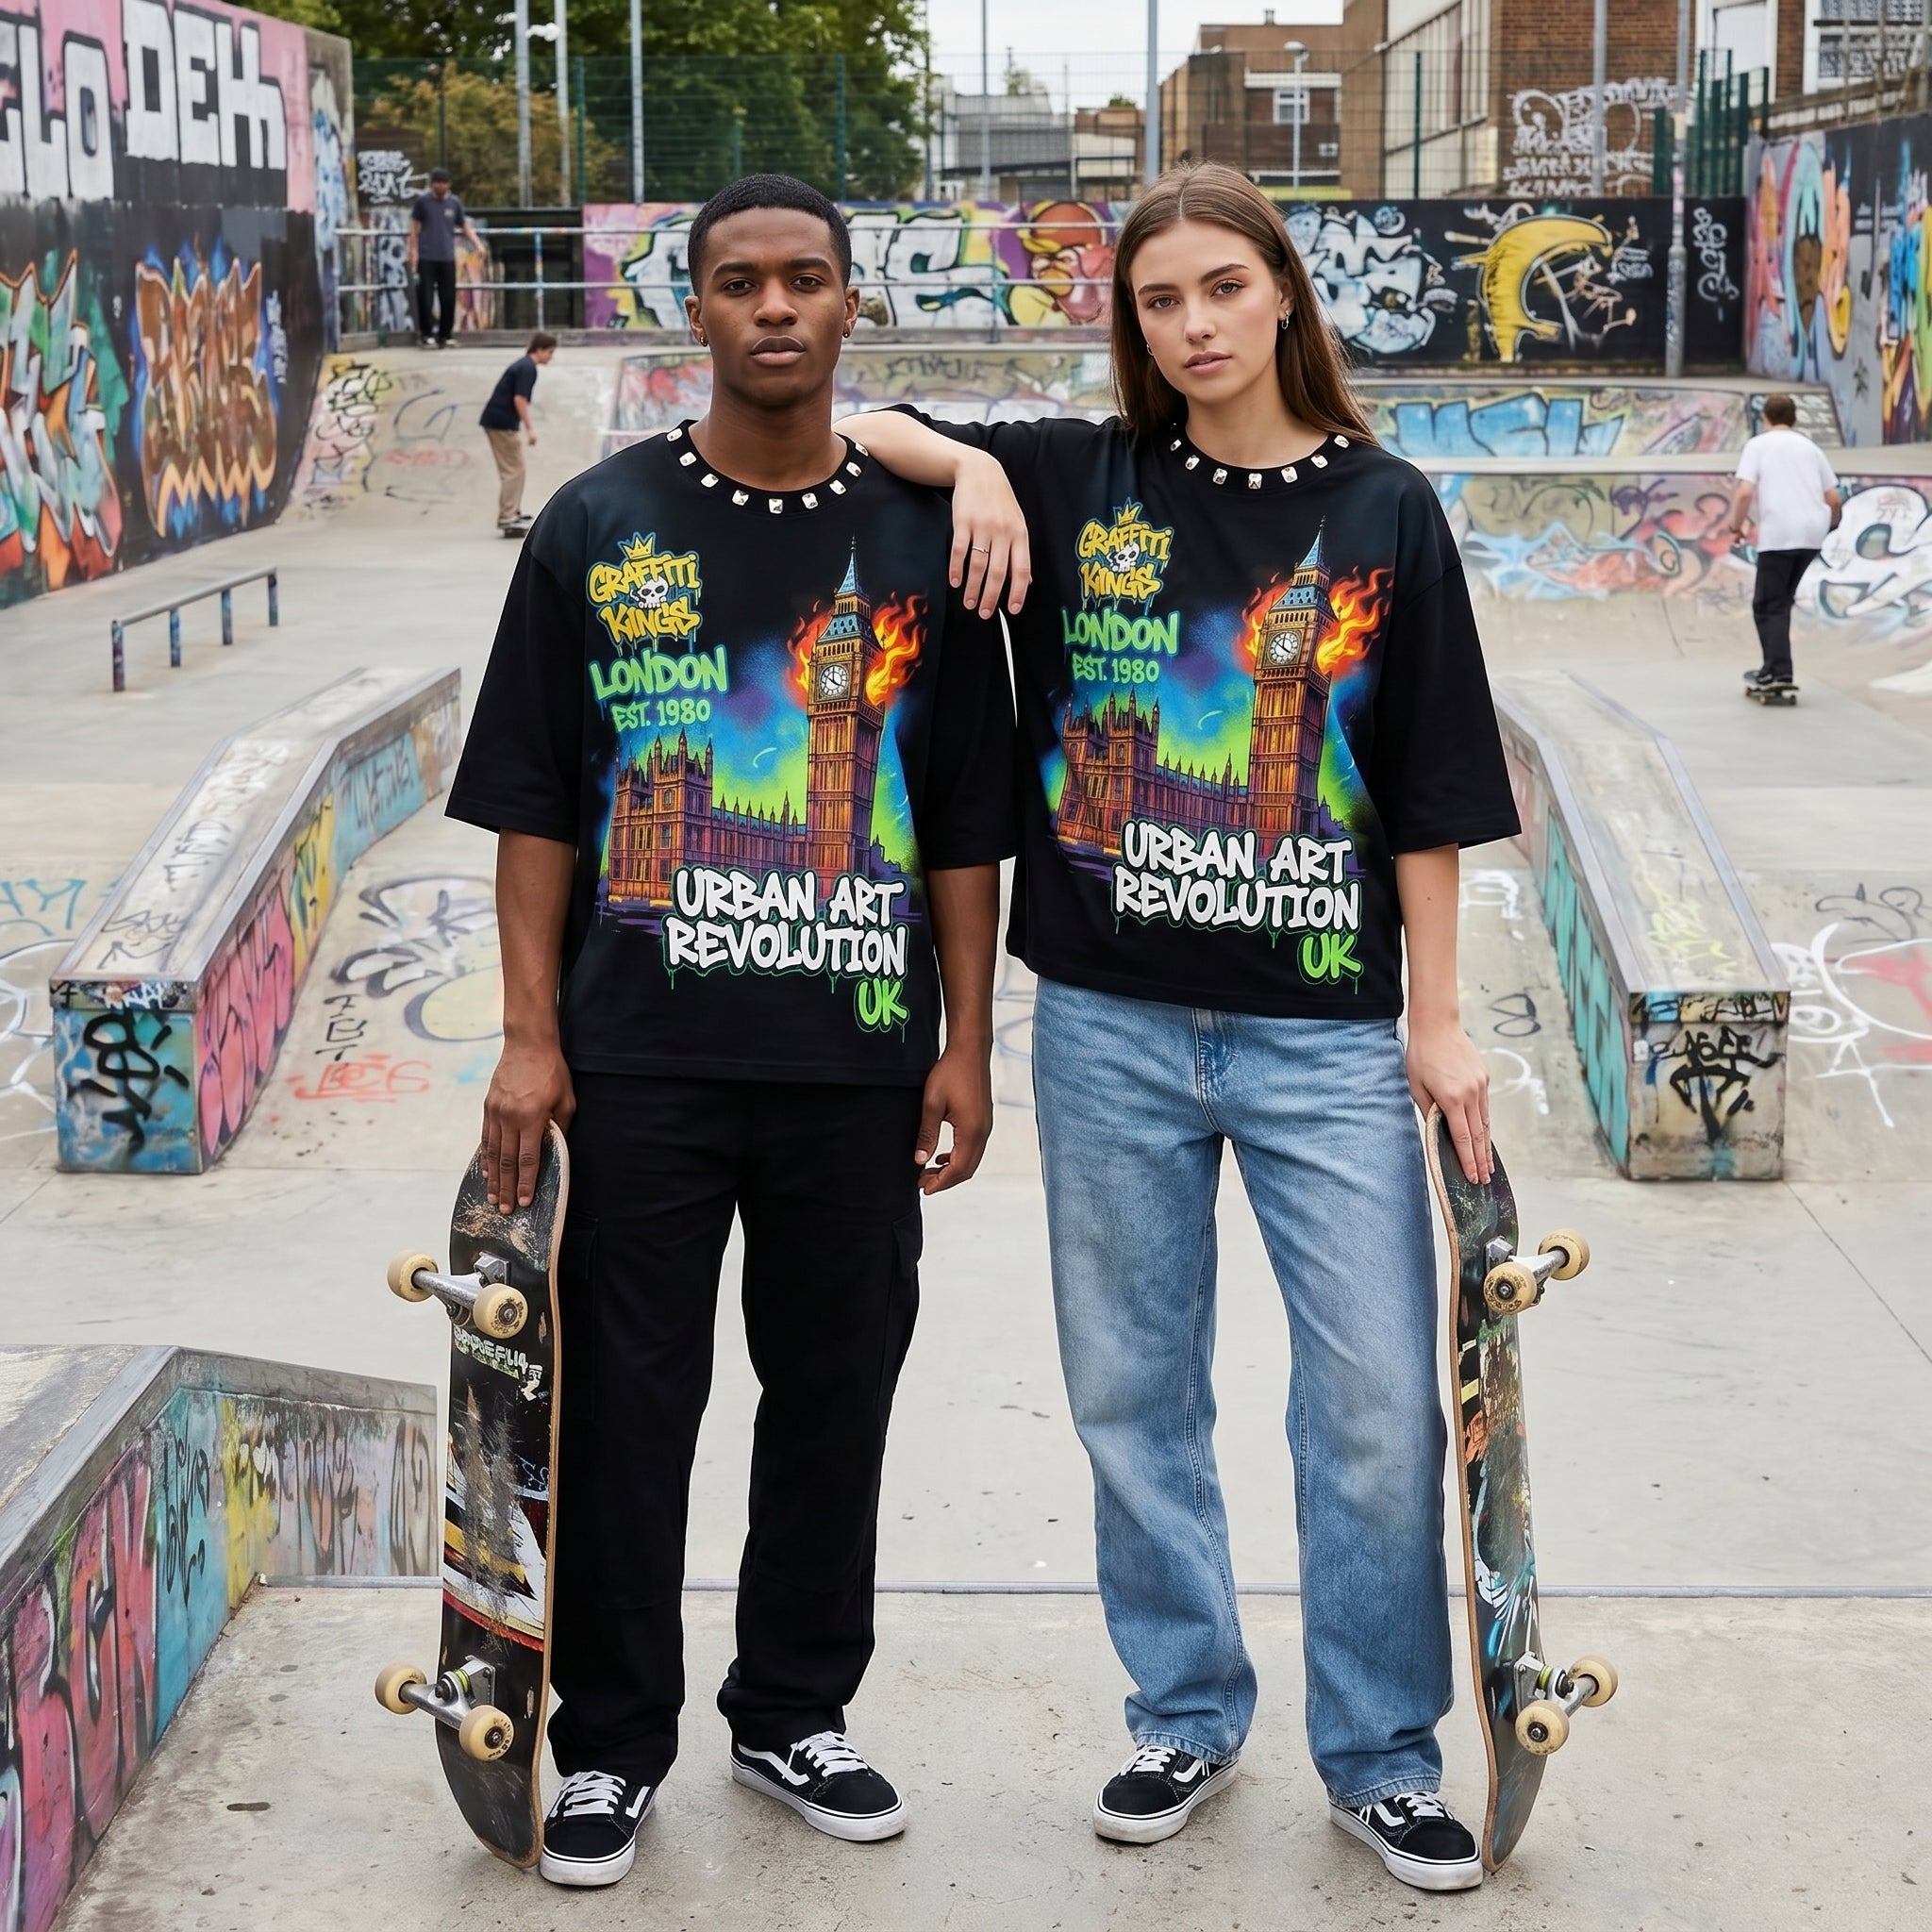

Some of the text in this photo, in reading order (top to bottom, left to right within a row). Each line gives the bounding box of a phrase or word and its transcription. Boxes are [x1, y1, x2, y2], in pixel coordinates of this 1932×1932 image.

[1080, 560, 1161, 600] KINGS
[600, 595, 701, 643] KINGS
[1062, 607, 1179, 655] LONDON
[589, 645, 728, 700] LONDON
[1072, 653, 1160, 684] EST. 1980
[612, 698, 710, 733] EST. 1980
[1124, 822, 1353, 884] URBAN ART
[675, 867, 906, 927] URBAN ART
[1114, 866, 1360, 930] REVOLUTION
[666, 915, 906, 976] REVOLUTION
[1303, 932, 1362, 979] UK
[858, 977, 908, 1026] UK
